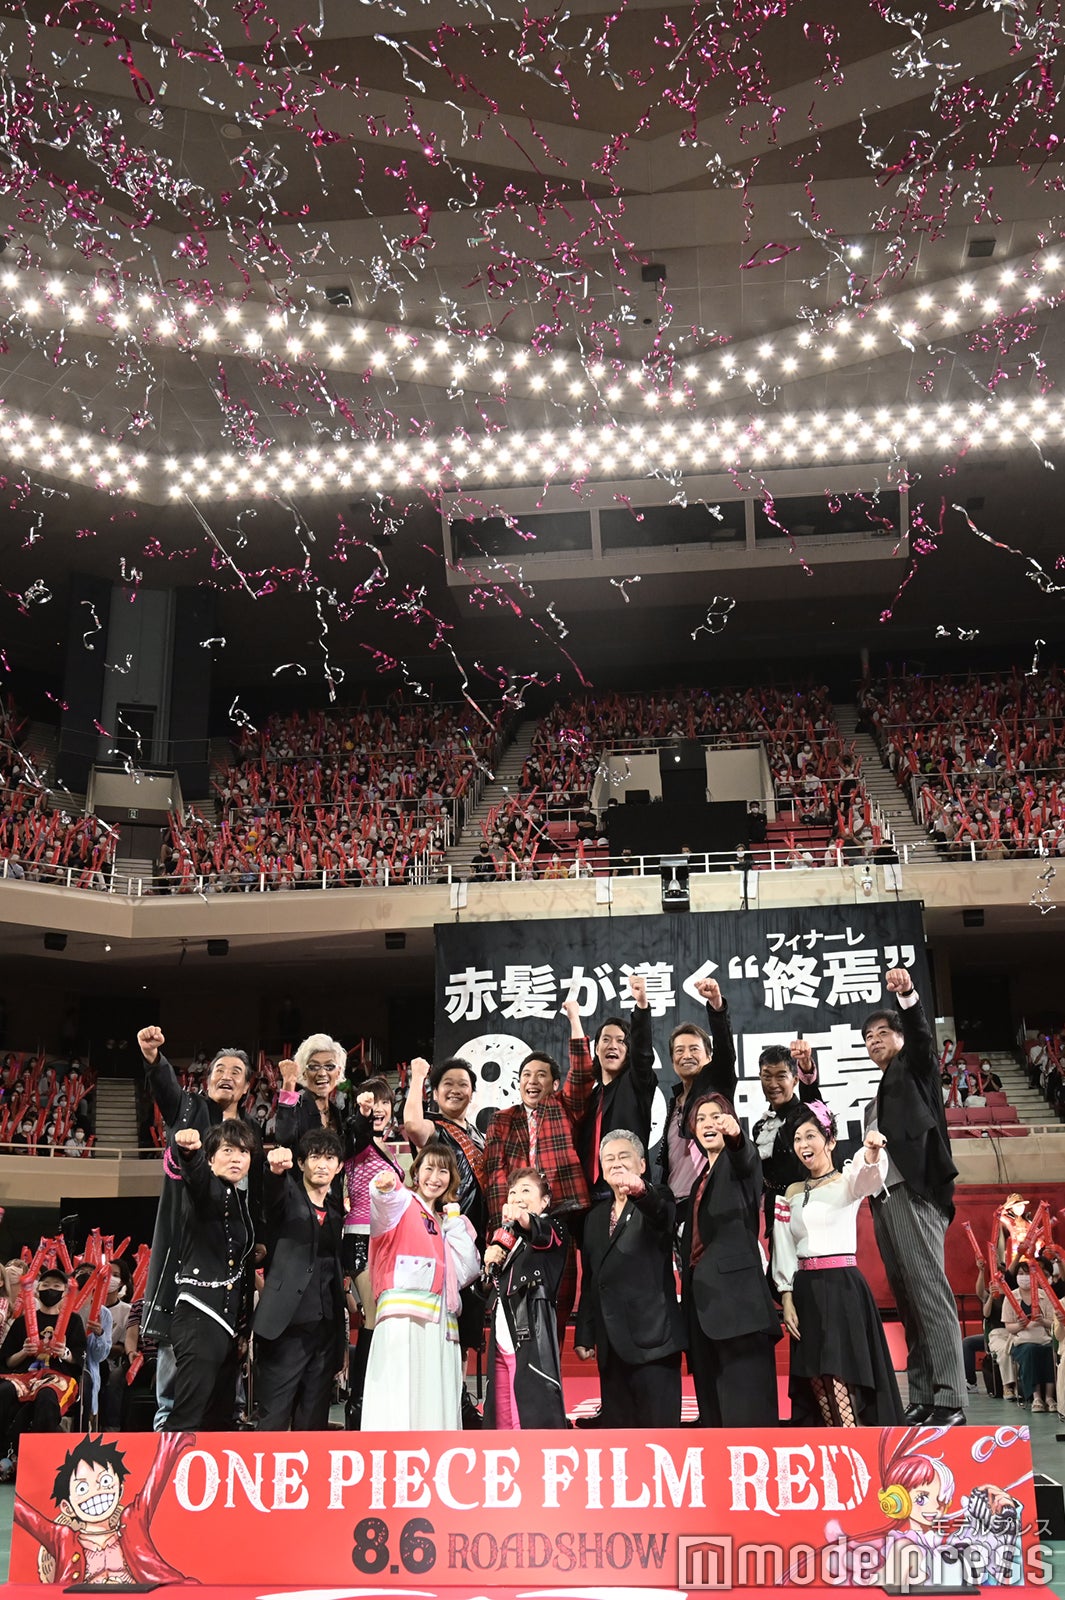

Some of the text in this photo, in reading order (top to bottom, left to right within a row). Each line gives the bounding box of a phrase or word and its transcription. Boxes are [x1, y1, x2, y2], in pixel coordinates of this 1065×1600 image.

[767, 927, 866, 953] フィナーレ
[172, 1443, 872, 1517] ONE PIECE FILM RED
[352, 1517, 670, 1575] 8.6 ROADSHOW
